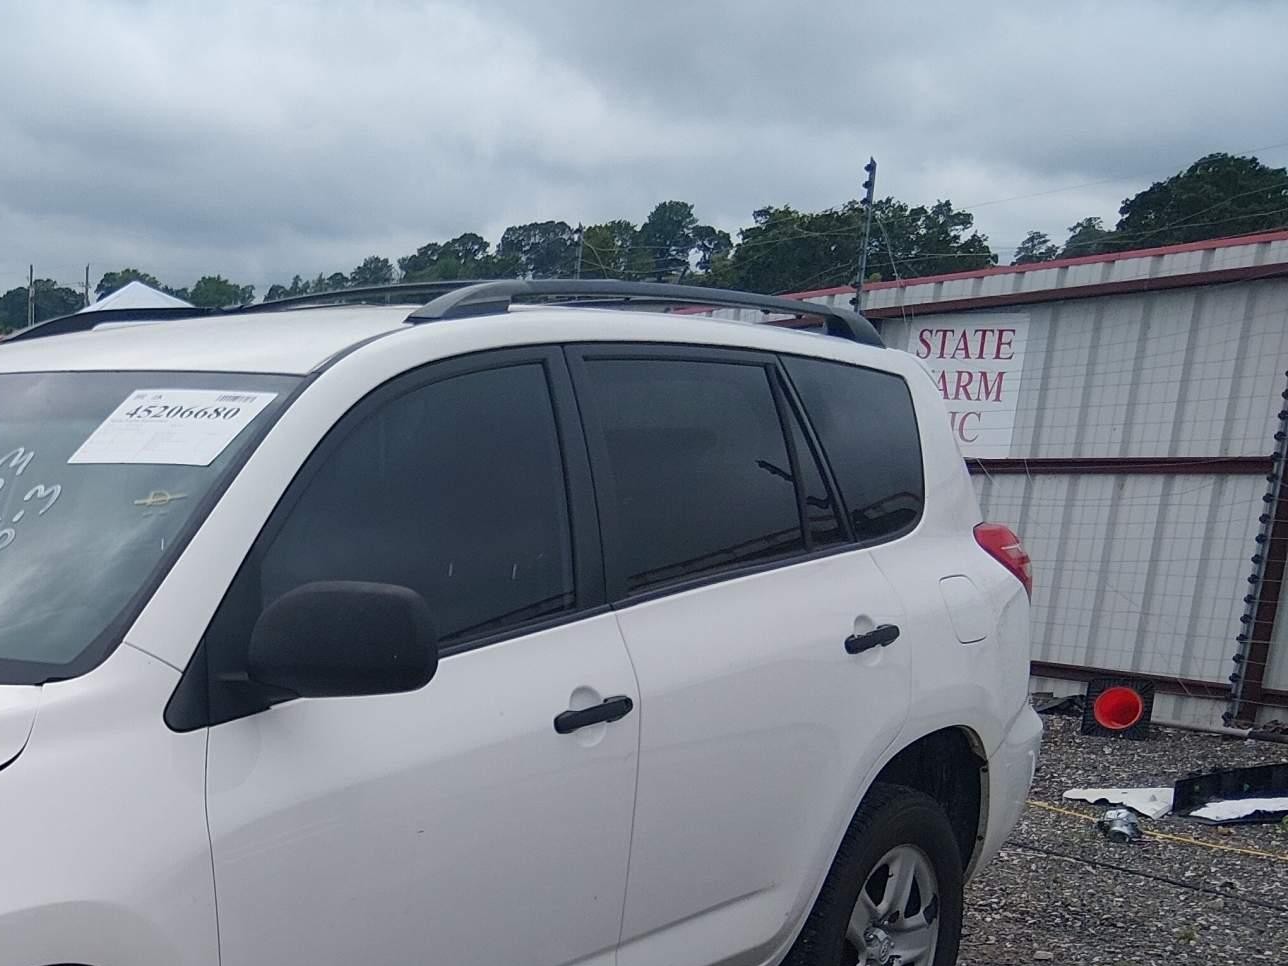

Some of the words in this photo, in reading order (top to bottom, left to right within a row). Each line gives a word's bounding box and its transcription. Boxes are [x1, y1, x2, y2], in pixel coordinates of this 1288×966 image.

[915, 328, 1017, 361] STATE
[934, 369, 1008, 403] ARM
[125, 404, 242, 421] 45206680
